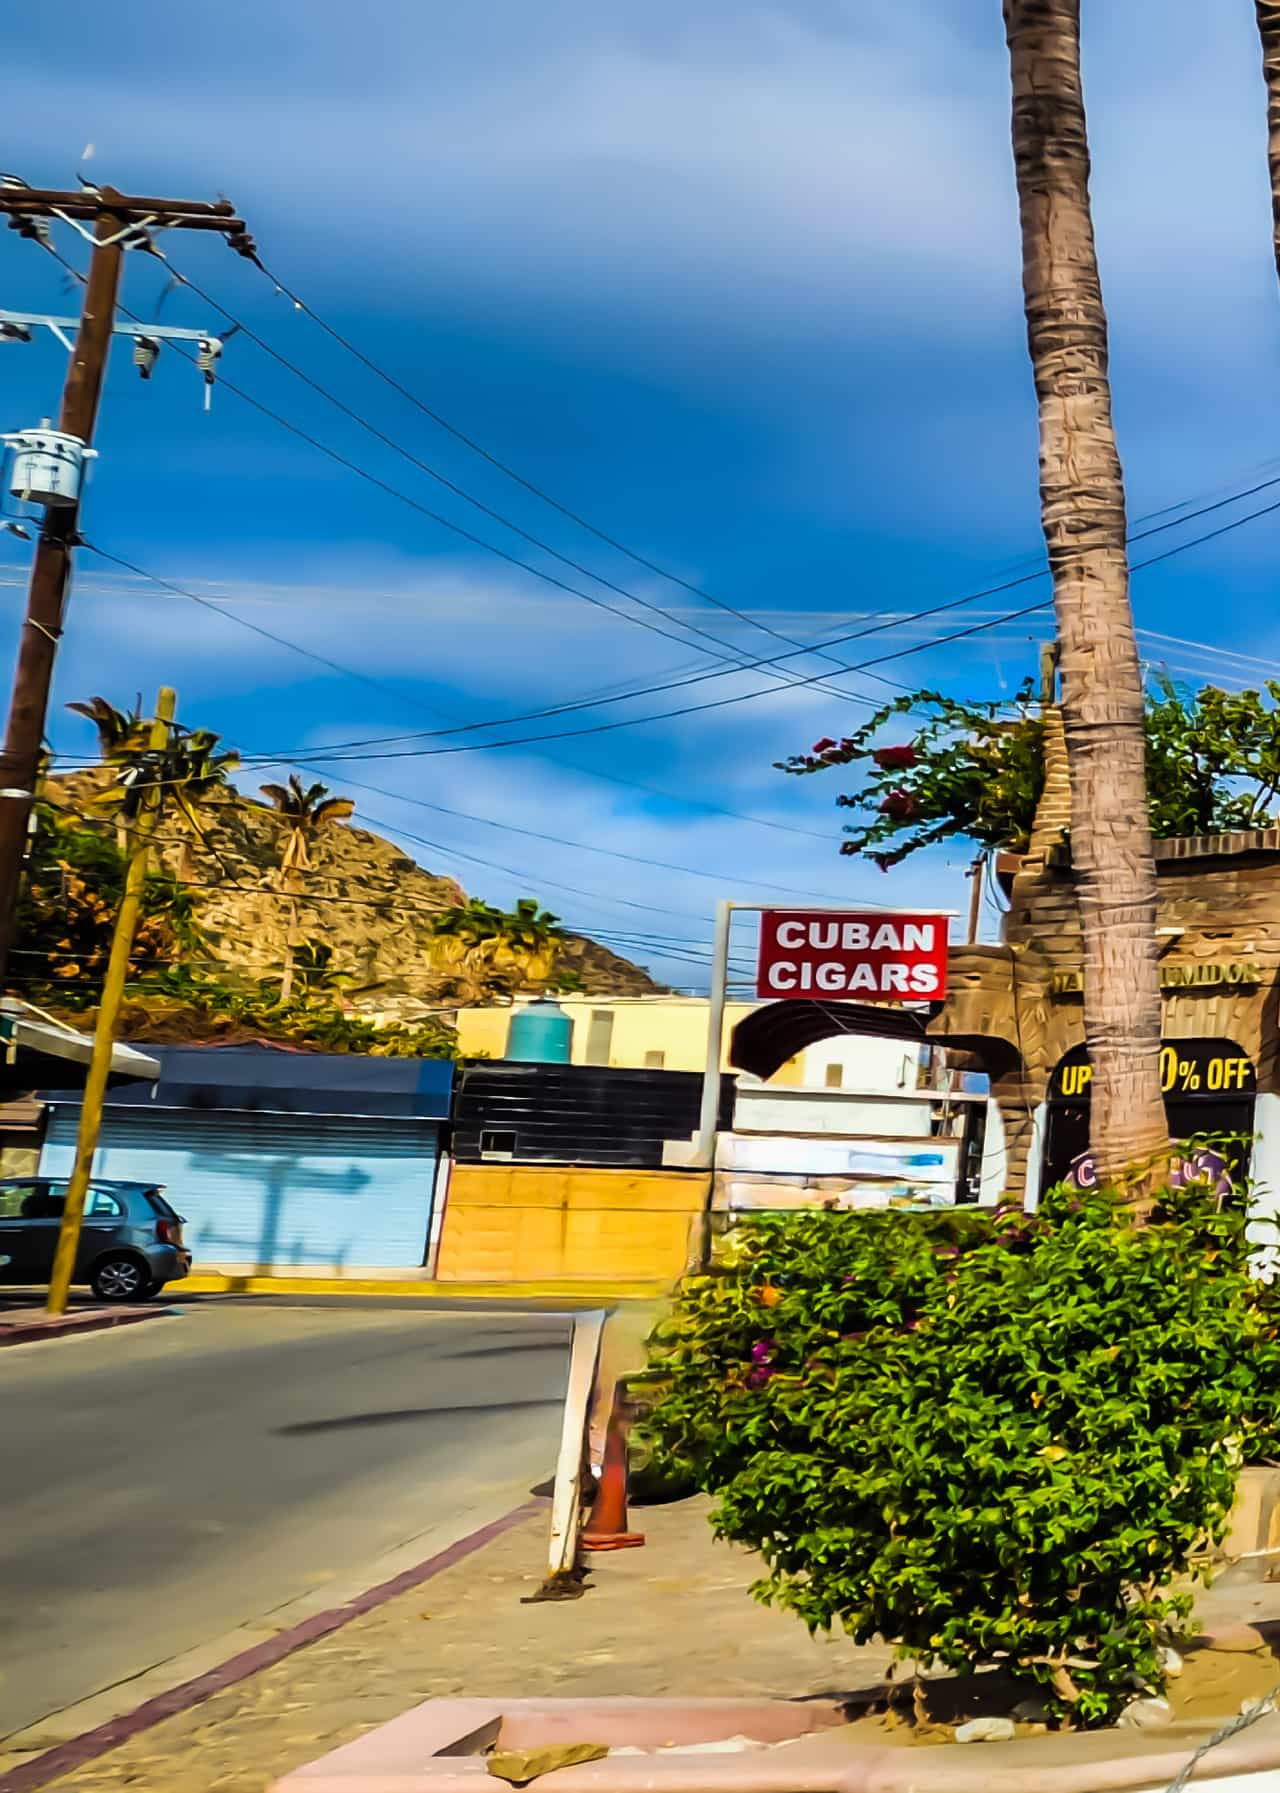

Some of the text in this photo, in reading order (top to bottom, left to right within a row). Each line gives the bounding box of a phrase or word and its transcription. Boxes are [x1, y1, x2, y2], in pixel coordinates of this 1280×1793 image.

[776, 920, 935, 953] CUBAN
[767, 960, 940, 993] CIGARS
[1061, 1046, 1251, 1096] UP 0% OFF
